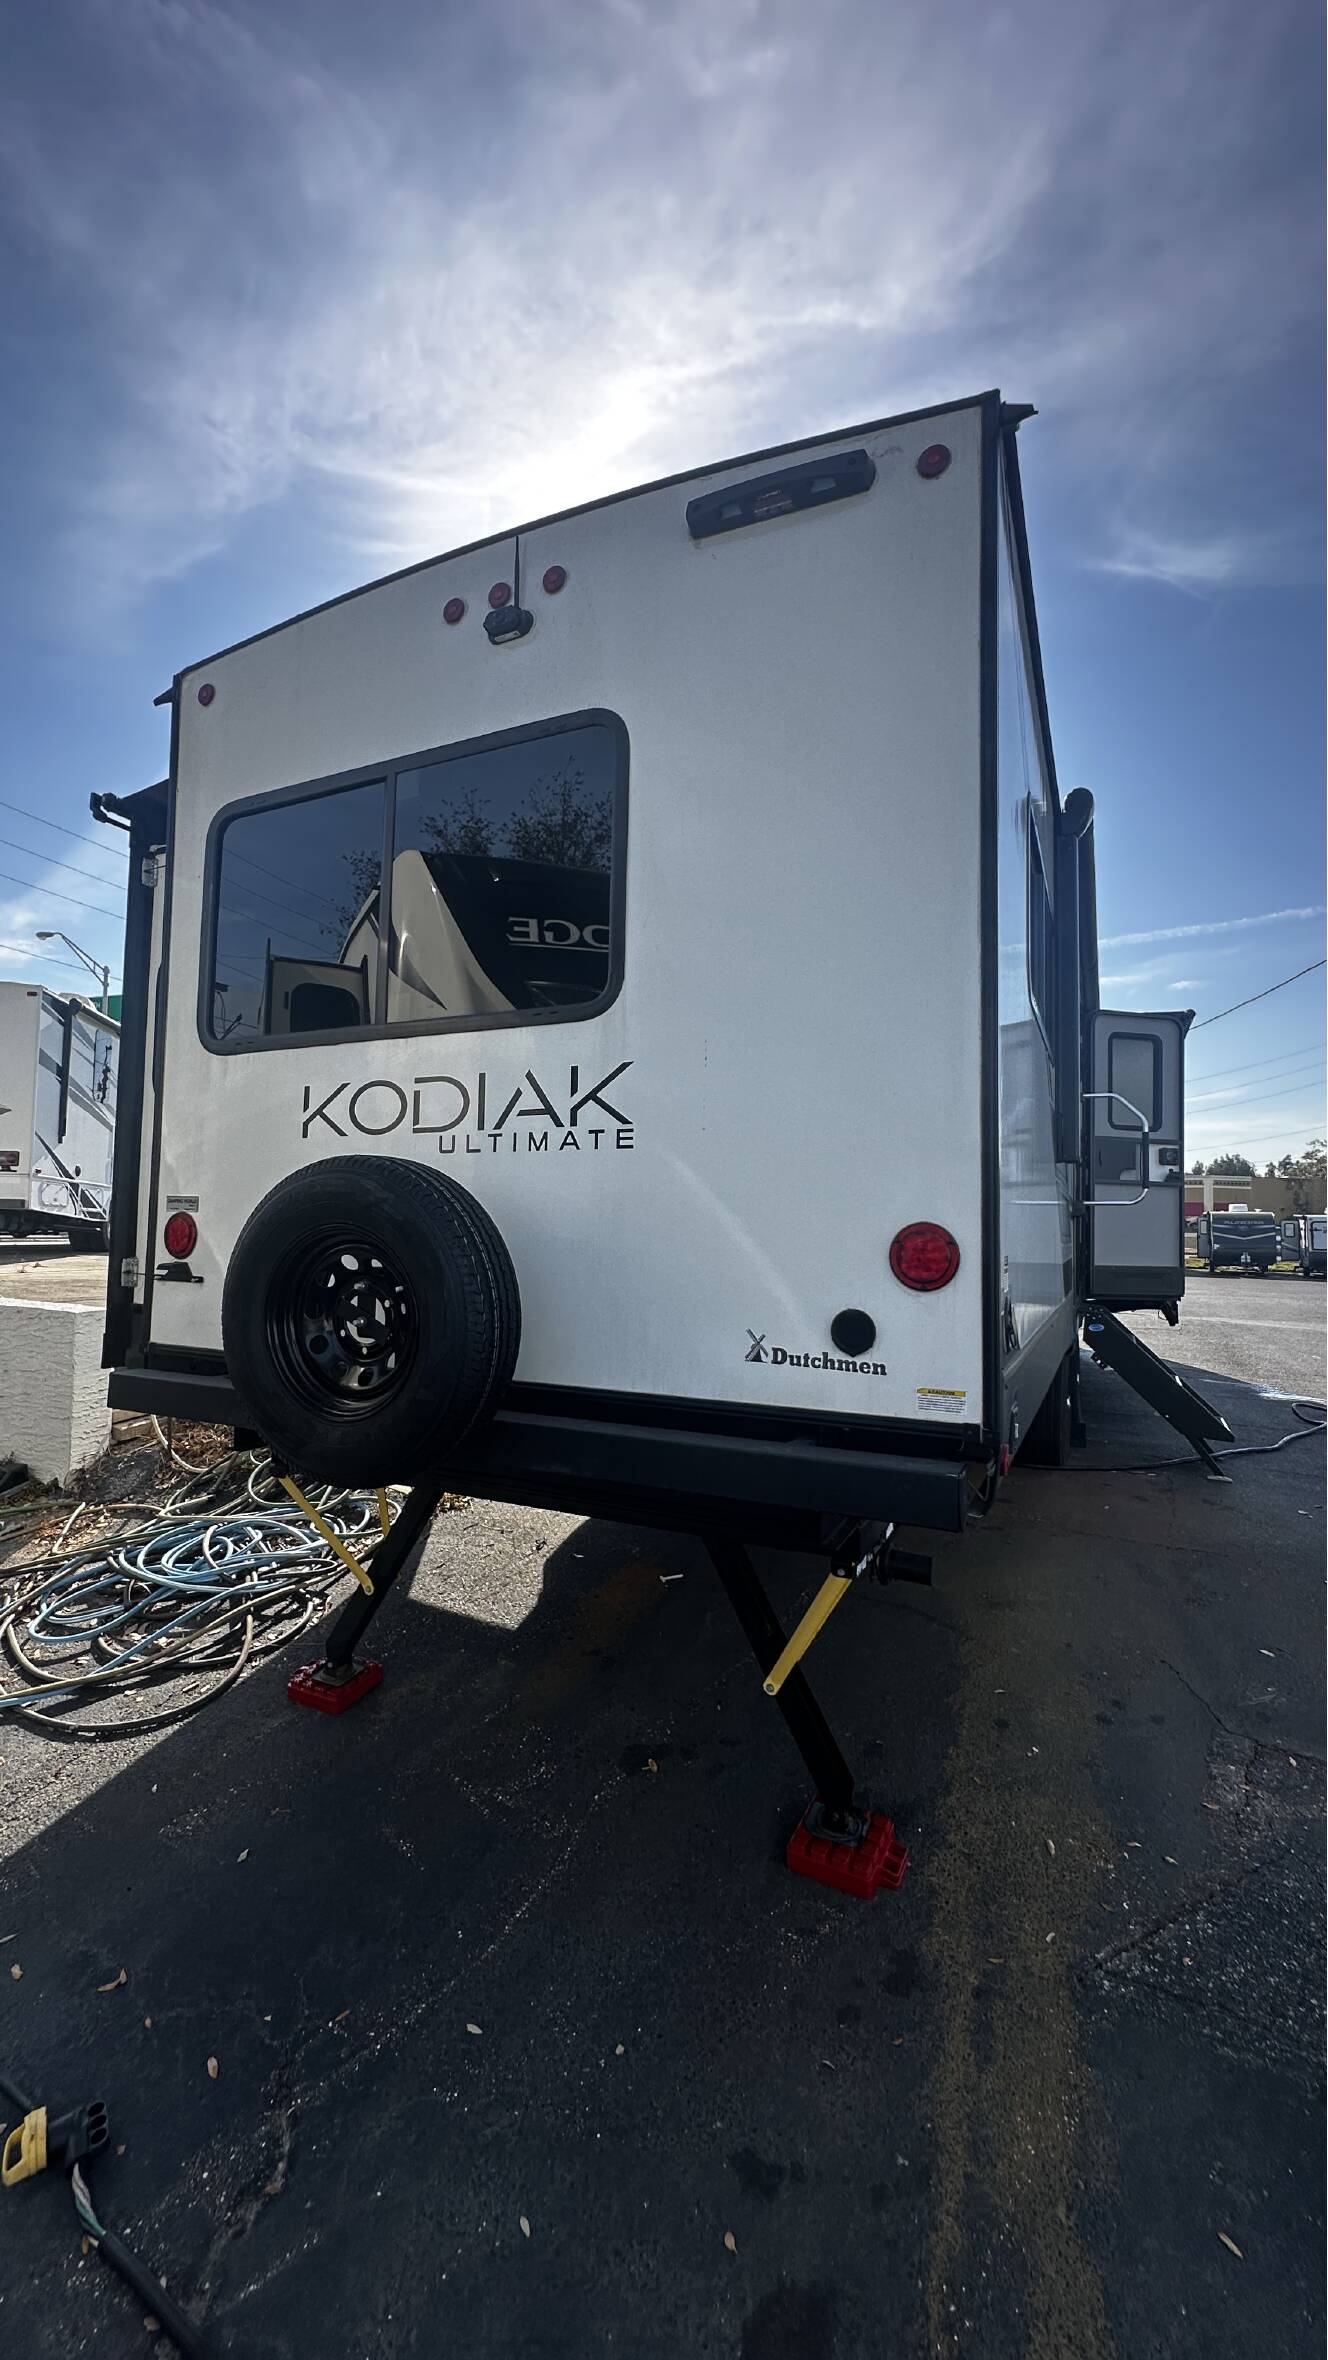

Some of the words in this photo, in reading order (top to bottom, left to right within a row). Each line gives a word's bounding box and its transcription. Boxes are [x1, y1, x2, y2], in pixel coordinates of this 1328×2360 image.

[302, 1061, 634, 1139] KODIAK
[438, 1128, 635, 1154] ULTIMATE
[771, 1347, 887, 1376] Dutchmen
